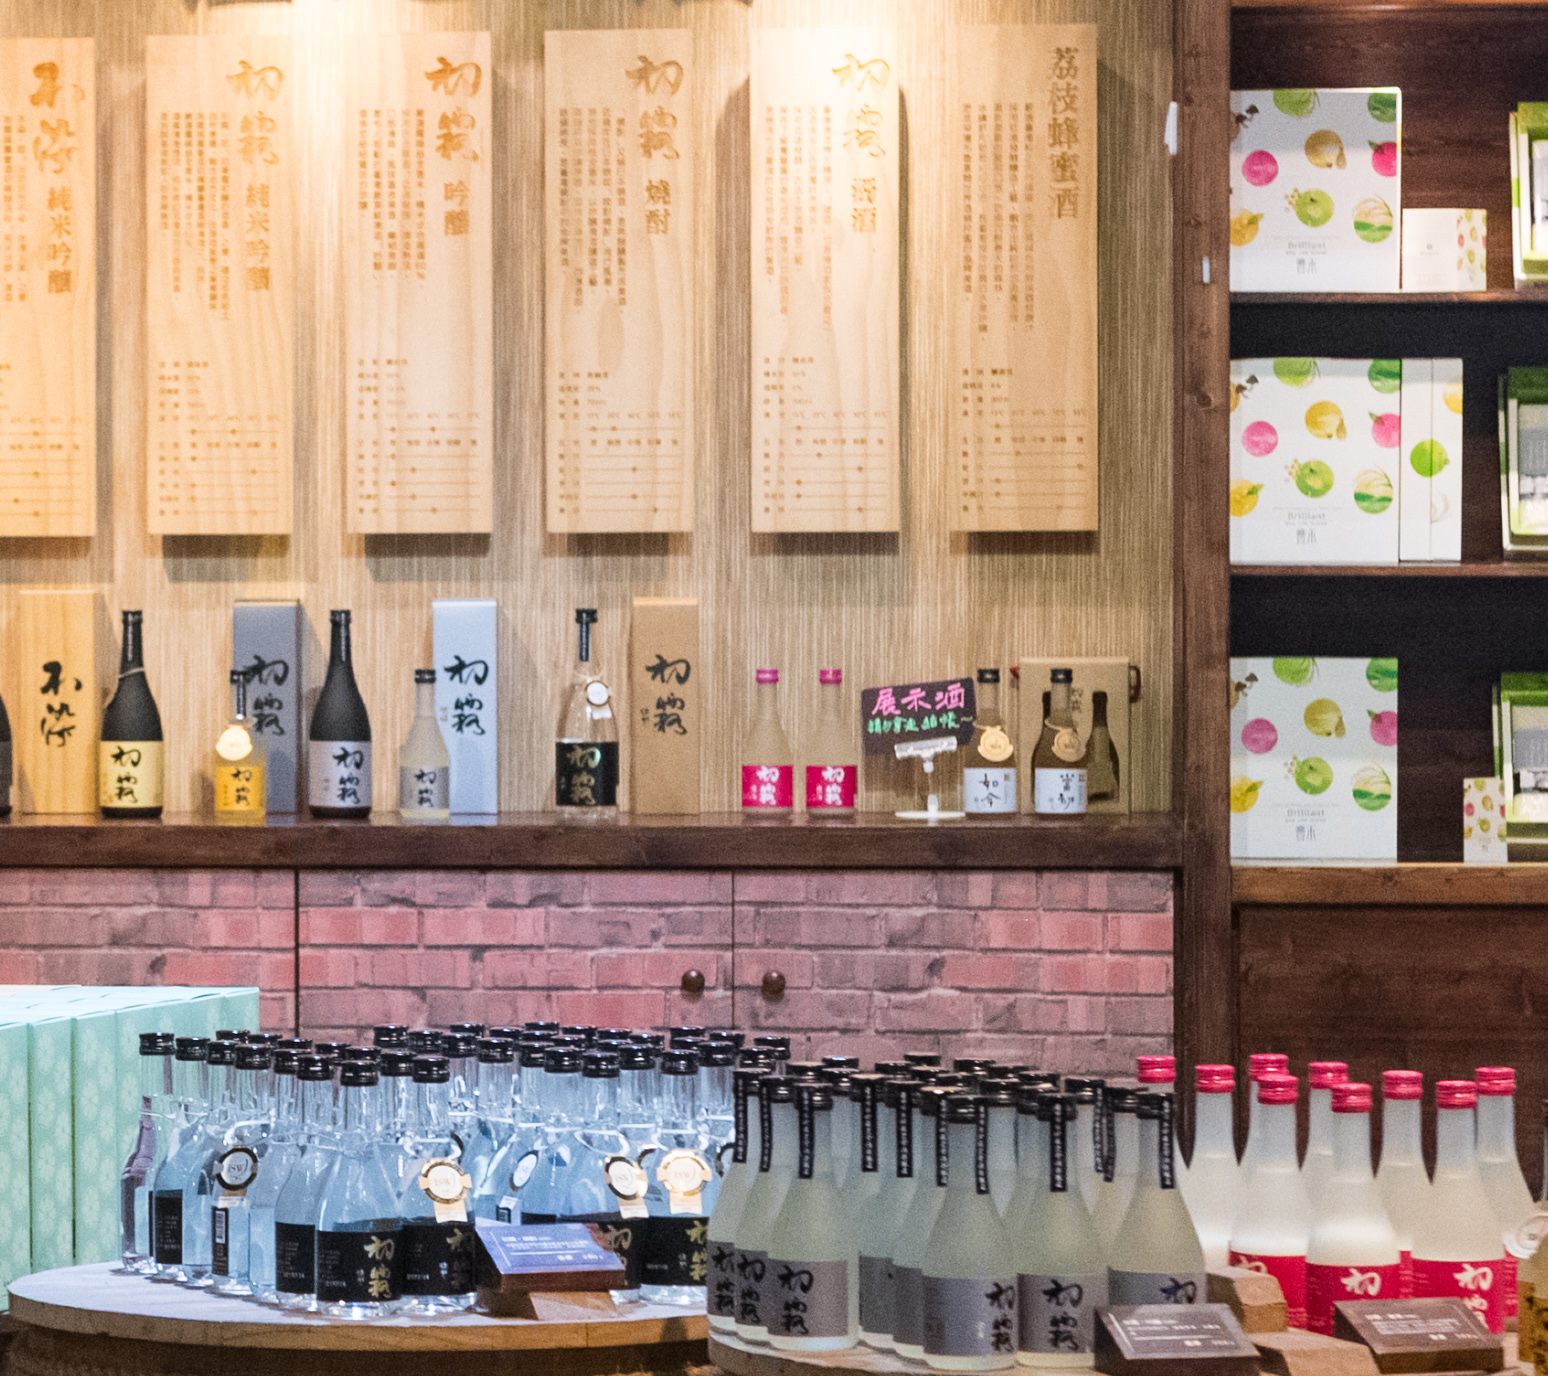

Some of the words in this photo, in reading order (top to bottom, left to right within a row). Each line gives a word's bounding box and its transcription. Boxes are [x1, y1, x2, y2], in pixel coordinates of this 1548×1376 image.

[1047, 46, 1080, 220] 荔枝蜂蜜酒
[47, 186, 73, 295] 純米吟釀
[245, 183, 271, 293] 純米吟釀
[443, 180, 471, 237] 吟釀
[871, 681, 966, 717] 展示酒
[363, 1234, 395, 1300] 初霧
[778, 1264, 813, 1336] 初霧
[985, 1282, 1016, 1353] 初霧
[1044, 1277, 1084, 1351] 初霧
